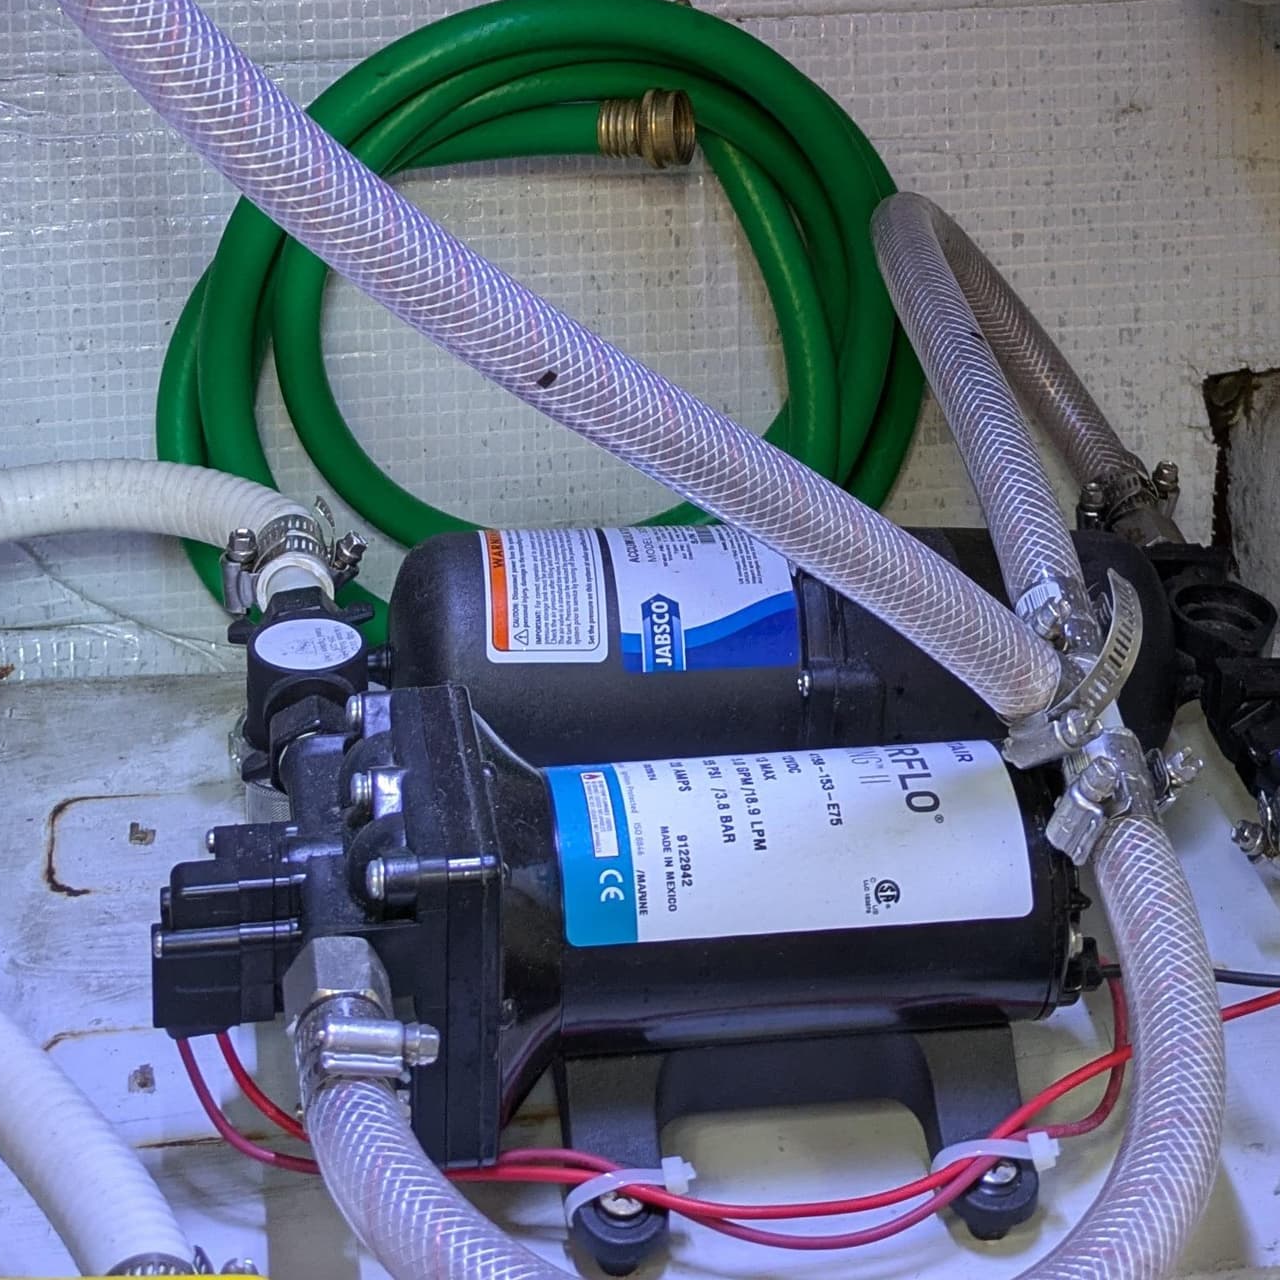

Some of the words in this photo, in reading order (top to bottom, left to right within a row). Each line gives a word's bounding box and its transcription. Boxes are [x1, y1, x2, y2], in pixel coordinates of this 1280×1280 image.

[651, 601, 672, 666] JABSCO
[675, 769, 691, 792] AMPS
[706, 767, 721, 779] PSI
[760, 763, 777, 781] MAX
[711, 788, 731, 810] /3.8
[633, 823, 643, 835] ISO
[720, 816, 736, 844] BAR
[740, 787, 761, 815] /18.9
[751, 821, 767, 851] LPM
[660, 826, 671, 853] MADE
[664, 857, 674, 868] IN
[677, 835, 693, 887] 9122942
[636, 870, 648, 916] /MARINE
[665, 872, 677, 912] MEXICO
